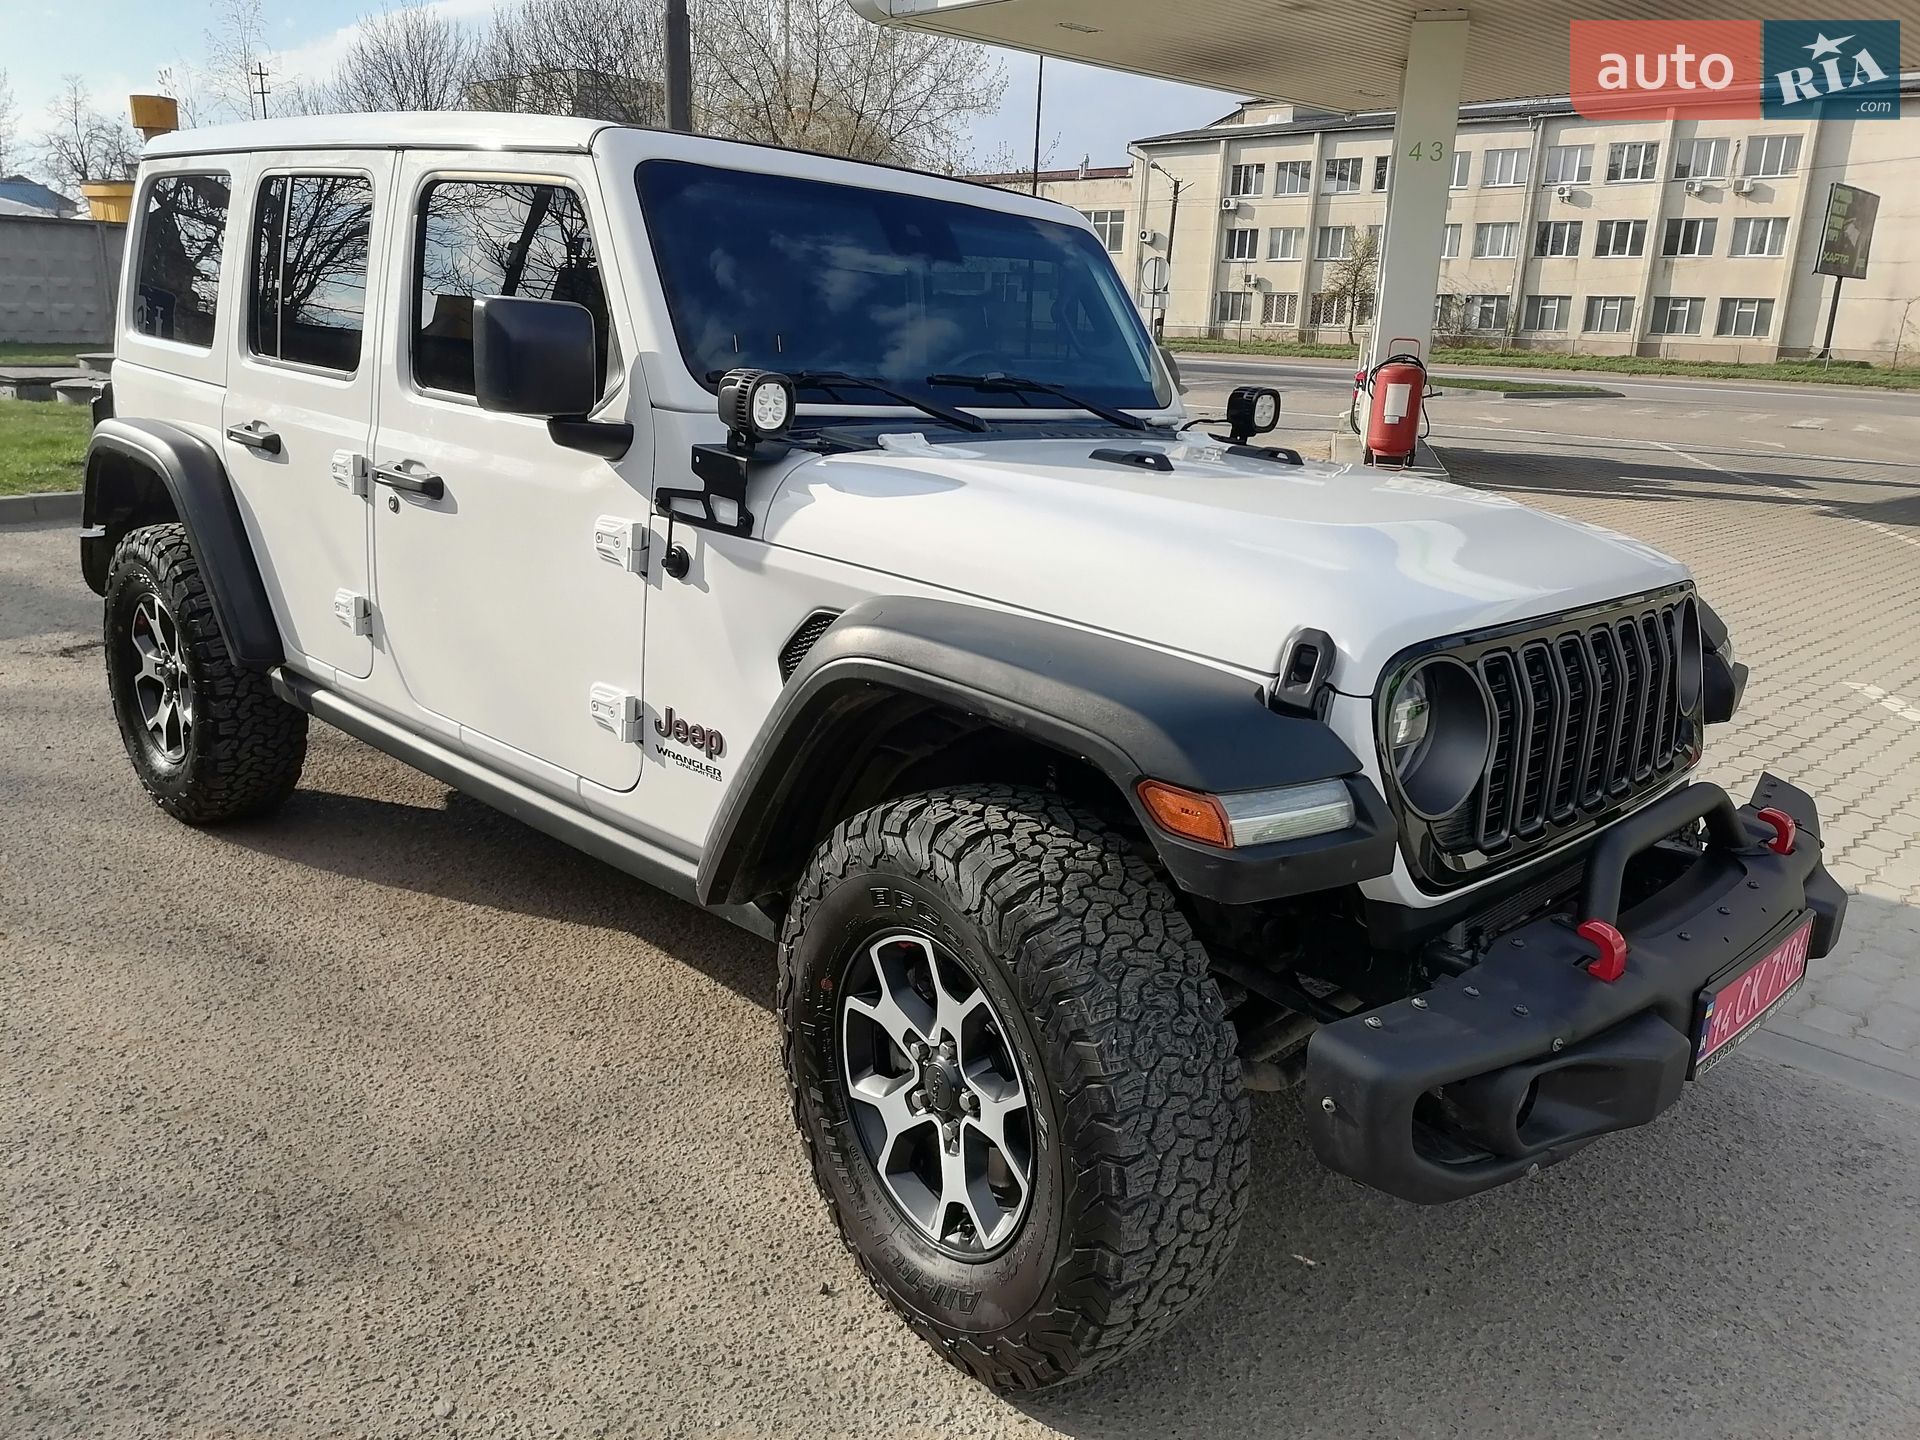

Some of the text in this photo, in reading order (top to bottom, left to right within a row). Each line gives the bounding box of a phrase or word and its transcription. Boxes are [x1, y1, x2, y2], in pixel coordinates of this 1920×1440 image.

[1408, 141, 1443, 162] 43
[654, 706, 724, 760] Jeep
[656, 744, 722, 778] WRANGLER
[675, 760, 722, 782] UNLIMITED
[1712, 1002, 1733, 1045] 14
[1735, 962, 1767, 1024] CK
[1766, 928, 1808, 1001] 7104
